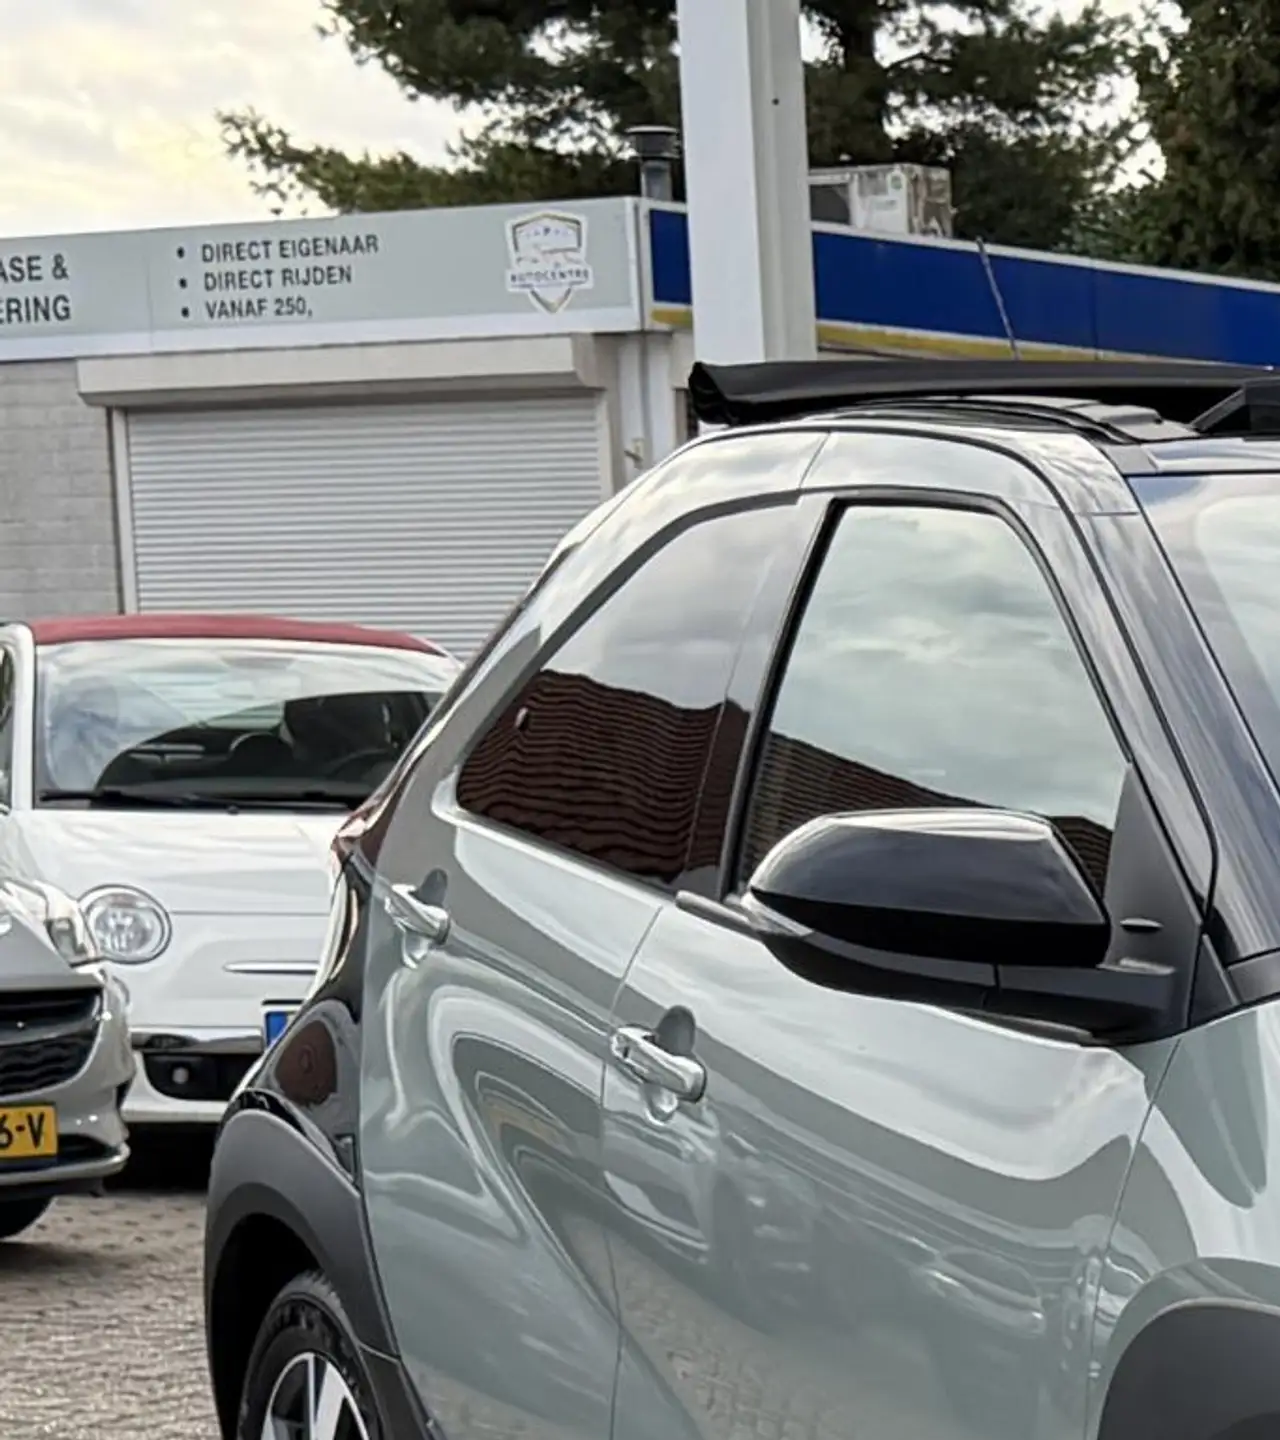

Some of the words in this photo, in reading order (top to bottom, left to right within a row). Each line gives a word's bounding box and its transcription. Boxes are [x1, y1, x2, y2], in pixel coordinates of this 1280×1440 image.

[202, 240, 273, 263] DIRECT
[278, 234, 379, 258] EIGENAAR
[51, 253, 69, 281] &
[204, 269, 274, 292] DIRECT
[281, 266, 352, 288] RIJDEN
[205, 300, 268, 319] VANAF
[274, 297, 313, 318] 250,
